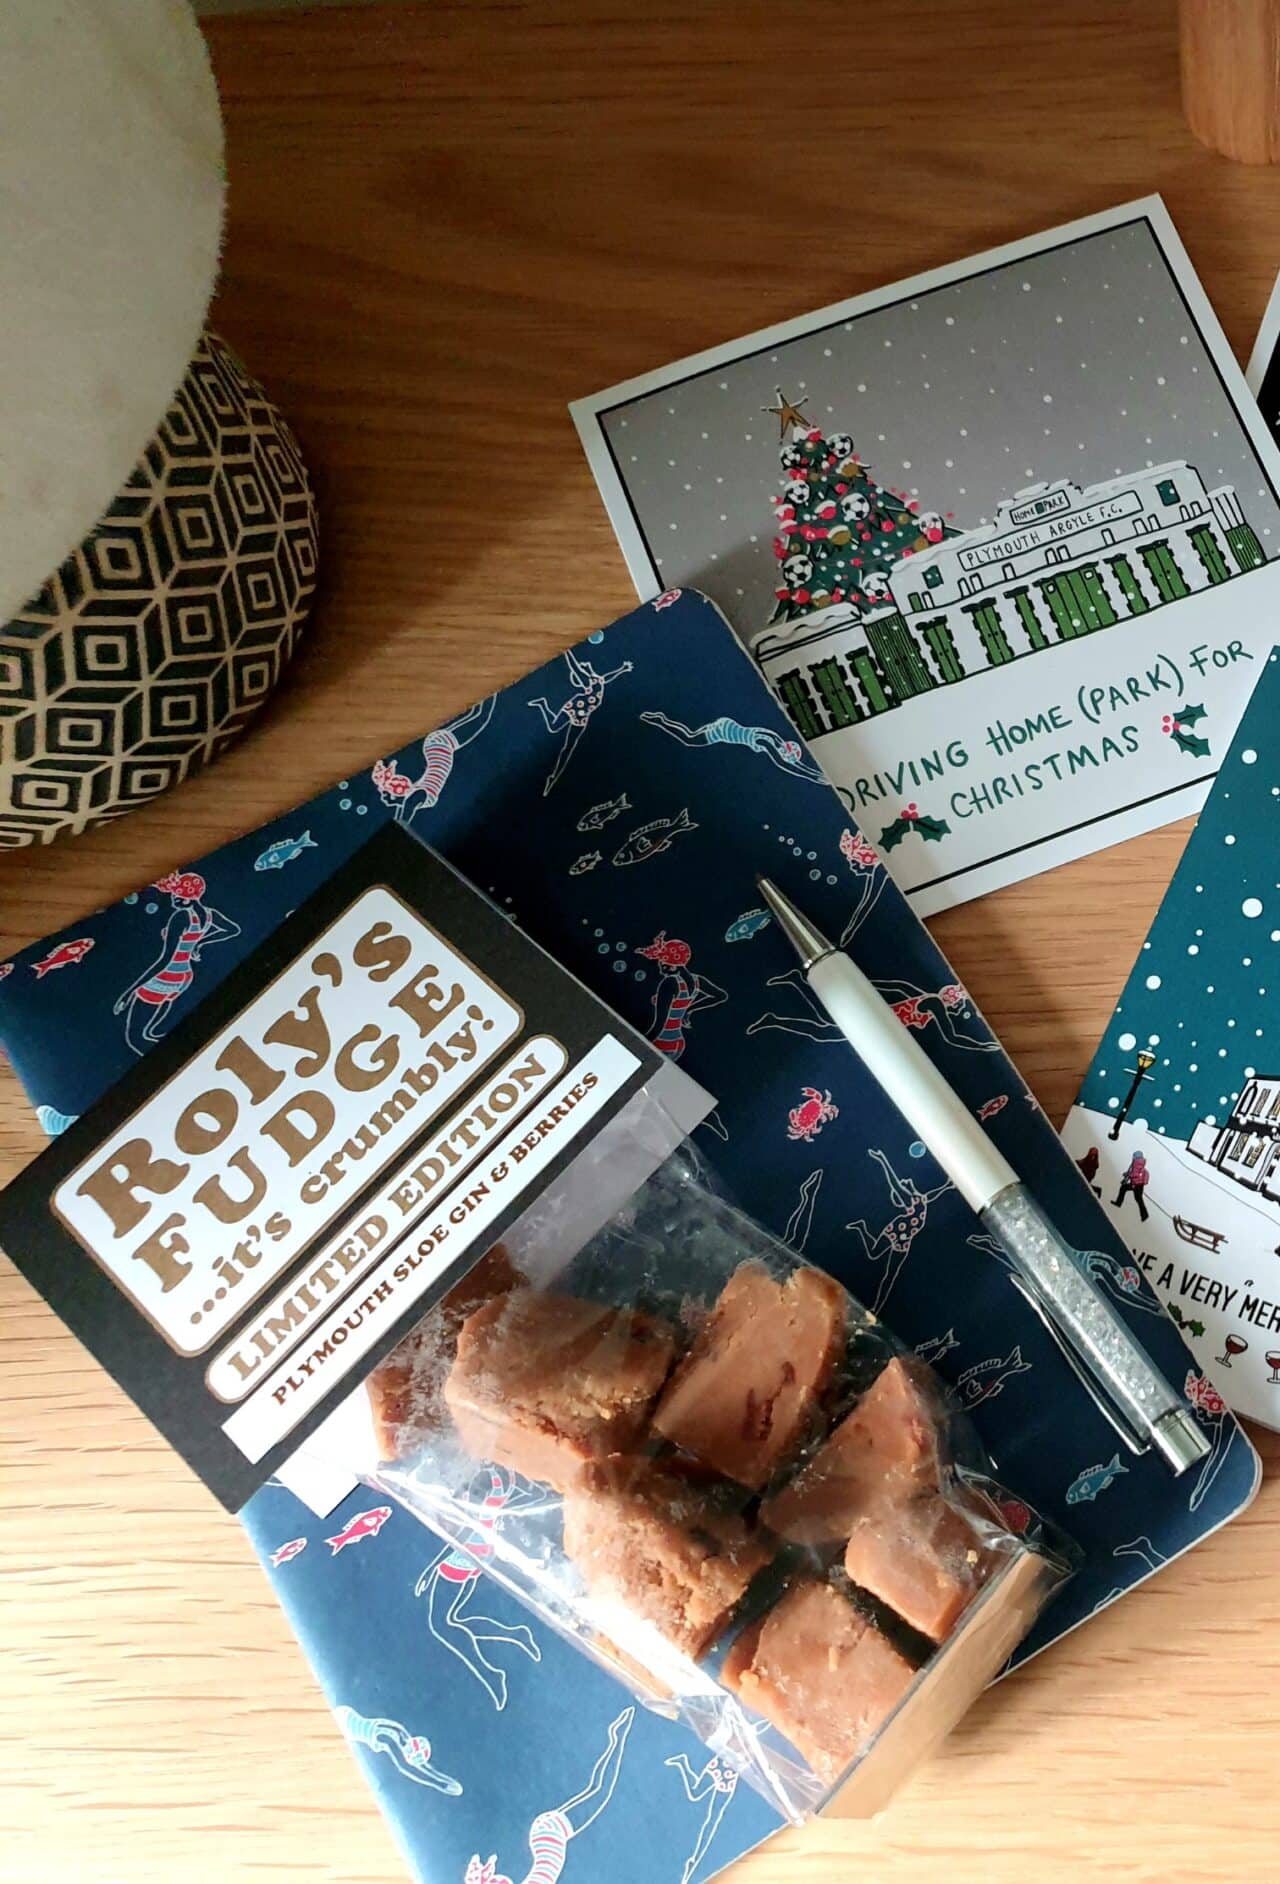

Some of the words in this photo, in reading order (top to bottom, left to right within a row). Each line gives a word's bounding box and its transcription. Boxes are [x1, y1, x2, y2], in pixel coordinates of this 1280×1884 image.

[967, 531, 1041, 567] PLYMOUTH
[1049, 512, 1095, 538] ARGYLE
[1100, 503, 1123, 519] F.C.
[1043, 495, 1065, 511] PARK
[985, 705, 1074, 757] HOME
[1077, 653, 1185, 725] (PARK)
[1188, 640, 1255, 677] FOR
[950, 725, 1141, 819] CHRISTMAS
[131, 964, 466, 1293] FUDGE
[300, 1003, 496, 1205] crumbly!
[229, 1214, 389, 1382] LIMITED
[387, 1053, 547, 1217] EDITION
[271, 1279, 395, 1406] PLYMOUTH
[392, 1224, 450, 1283] SLOE
[448, 1181, 491, 1225] GIN
[490, 1160, 510, 1184] &
[507, 1071, 599, 1164] BERRIES
[1156, 1262, 1175, 1290] A
[1179, 1269, 1239, 1313] VERY
